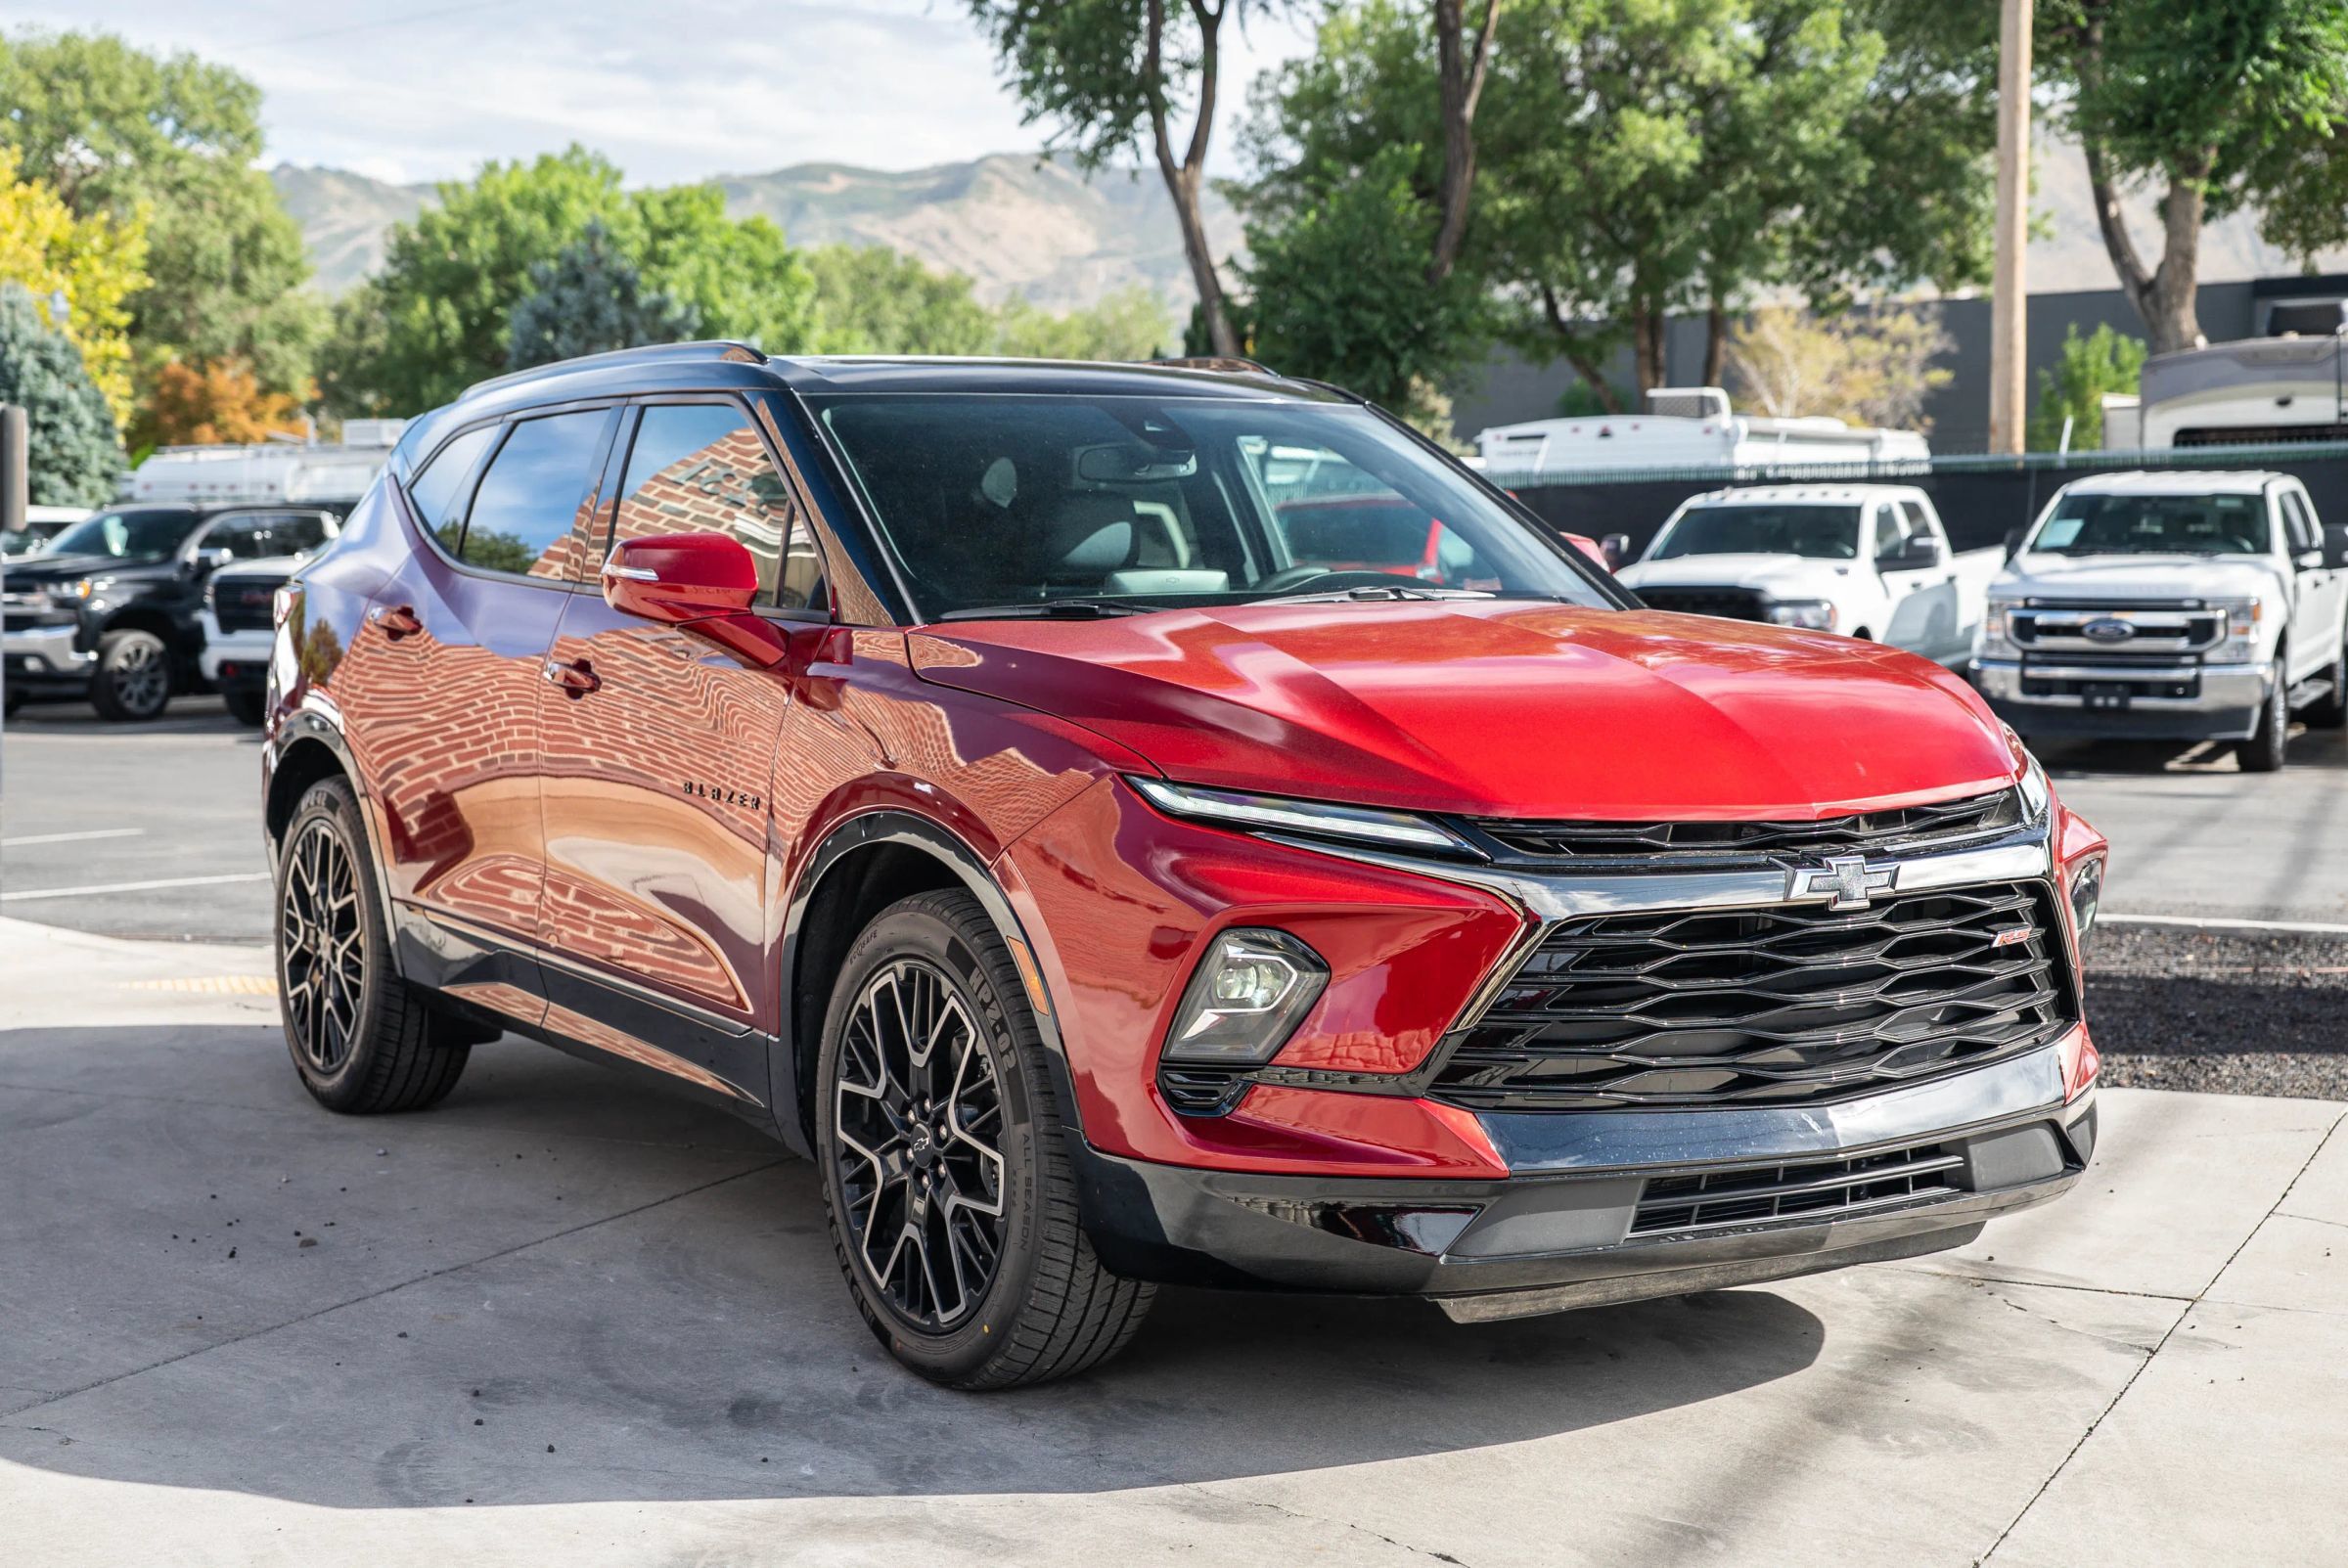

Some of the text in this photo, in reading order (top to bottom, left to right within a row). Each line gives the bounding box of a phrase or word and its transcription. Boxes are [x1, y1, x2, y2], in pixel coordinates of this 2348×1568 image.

[683, 781, 761, 810] BLAZER
[1993, 926, 2032, 948] RS
[1018, 1134, 1033, 1251] ALL SEASON
